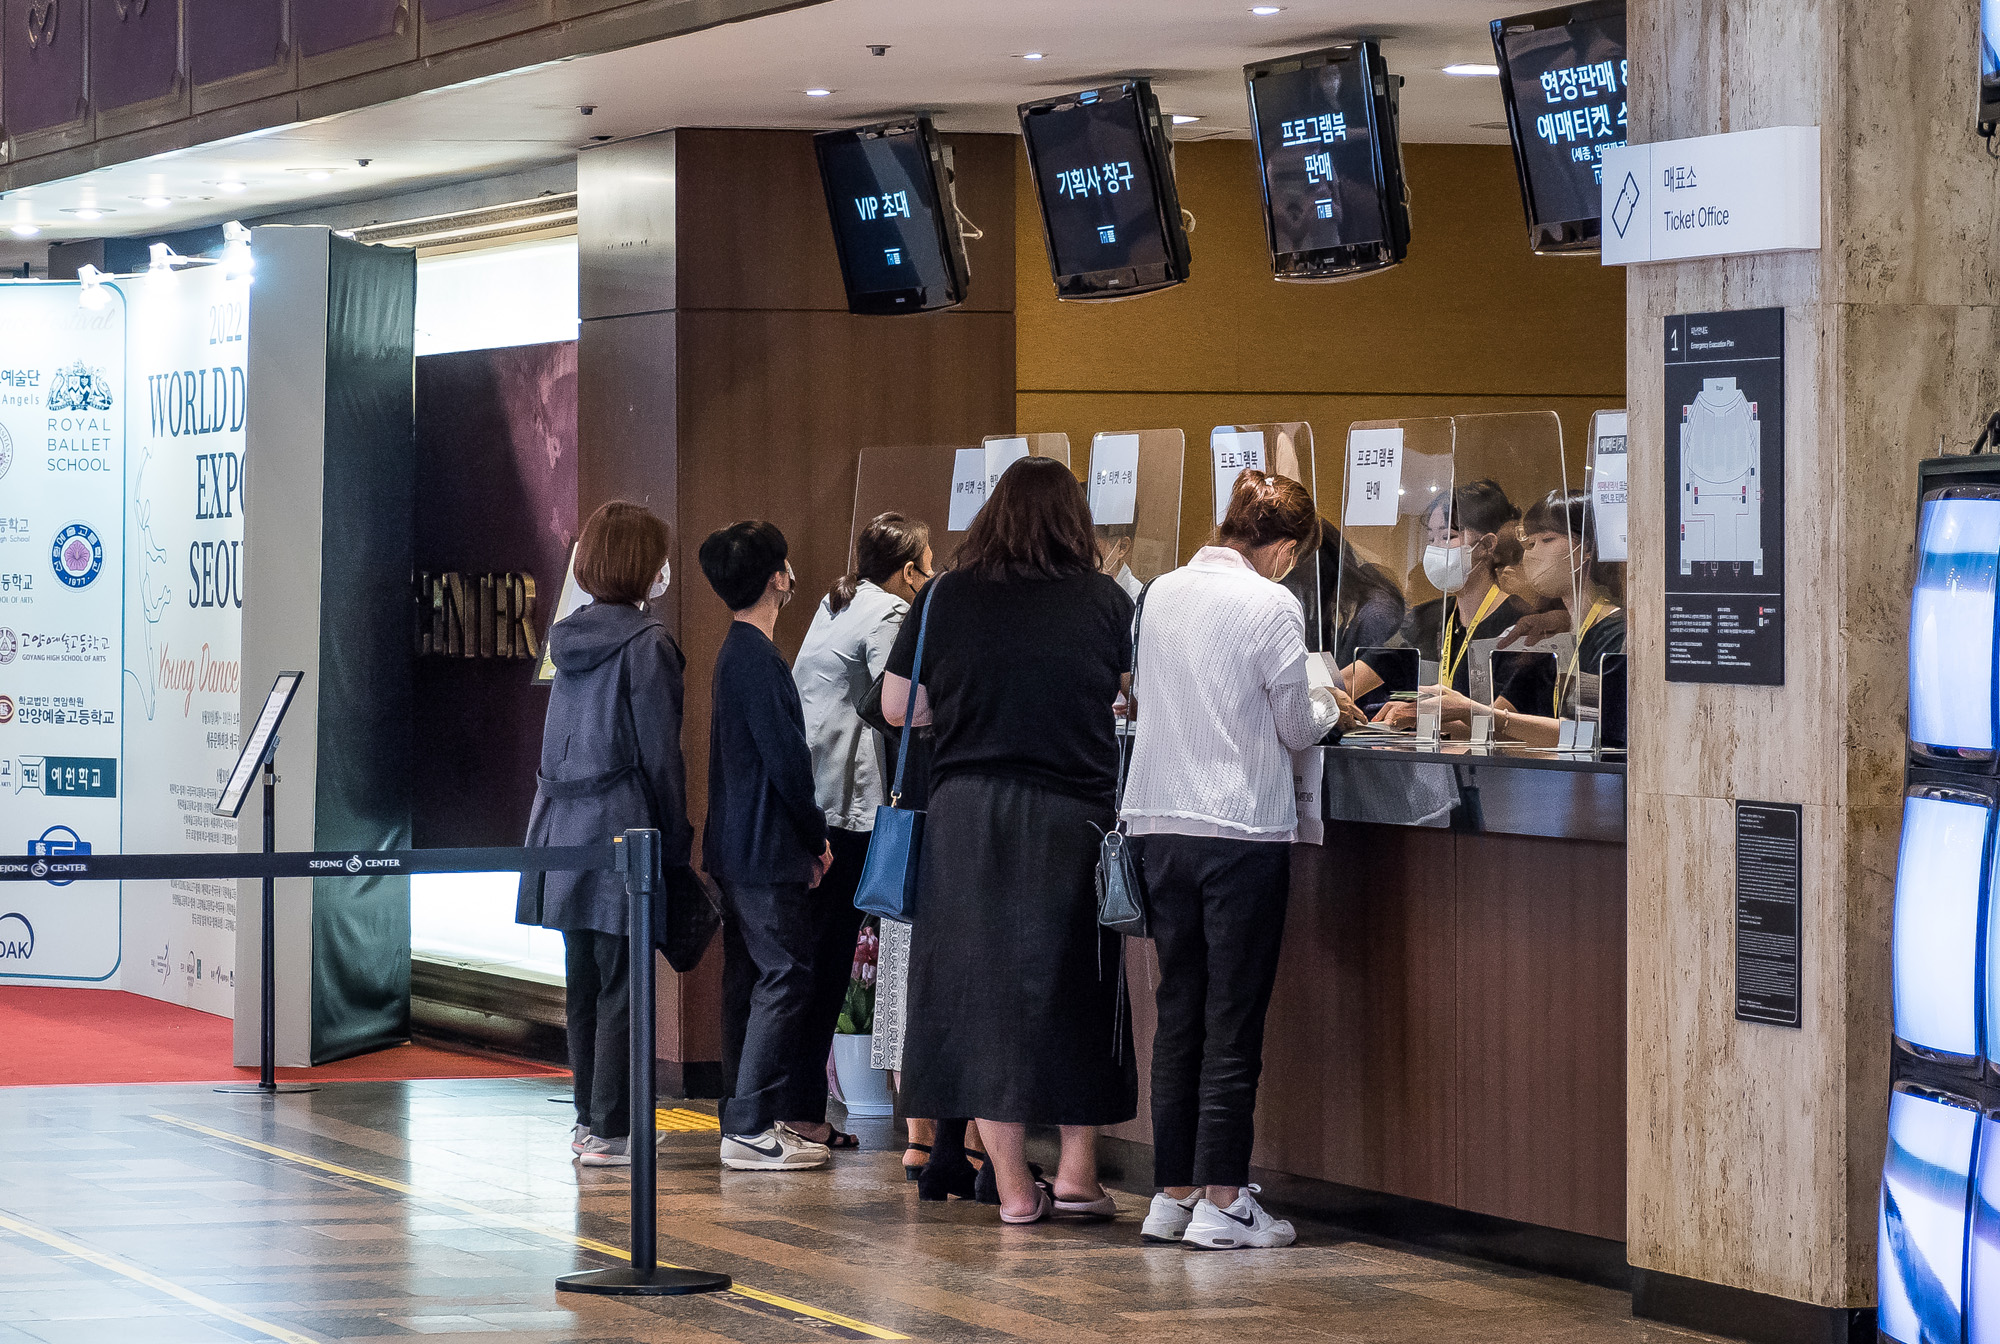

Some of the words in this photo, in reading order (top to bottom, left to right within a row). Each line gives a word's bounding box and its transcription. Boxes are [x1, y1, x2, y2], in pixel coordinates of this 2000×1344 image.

[1540, 60, 1617, 104] 현장판매
[1281, 111, 1347, 147] 프로그램북
[1537, 104, 1613, 145] 예매티켓
[1304, 152, 1333, 184] 판매
[1056, 166, 1102, 200] 기획사
[1102, 161, 1134, 194] 창구
[1663, 165, 1698, 193] 매표소
[855, 196, 878, 220] VIP
[881, 190, 911, 219] 초대
[1664, 210, 1696, 232] Ticket
[1698, 205, 1730, 228] Office
[209, 302, 242, 345] 2022
[1670, 329, 1679, 351] 1
[0, 369, 41, 387] 예술단
[2, 393, 40, 407] Angels
[148, 367, 227, 438] WORLD
[229, 366, 247, 432] D
[47, 418, 112, 431] ROYAL
[47, 438, 112, 451] BALLET
[47, 458, 111, 471] SCHOOL
[1220, 450, 1259, 470] 프로그램북
[1356, 447, 1395, 468] 프로그램북
[965, 480, 975, 494] 티켓
[1109, 470, 1120, 485] 티켓
[1121, 470, 1133, 485] 수령
[1366, 480, 1381, 500] 판매
[21, 633, 110, 653] 고양예술고등학교
[61, 654, 83, 662] SCHOOL
[93, 655, 107, 663] ARTS
[158, 641, 196, 718] Young
[199, 643, 240, 694] Dance
[18, 708, 115, 725] 안양예술고등학교
[51, 767, 101, 791] 예원학교
[50, 863, 88, 872] CENTER
[309, 860, 343, 869] SEJONG
[365, 859, 400, 867] CENTER
